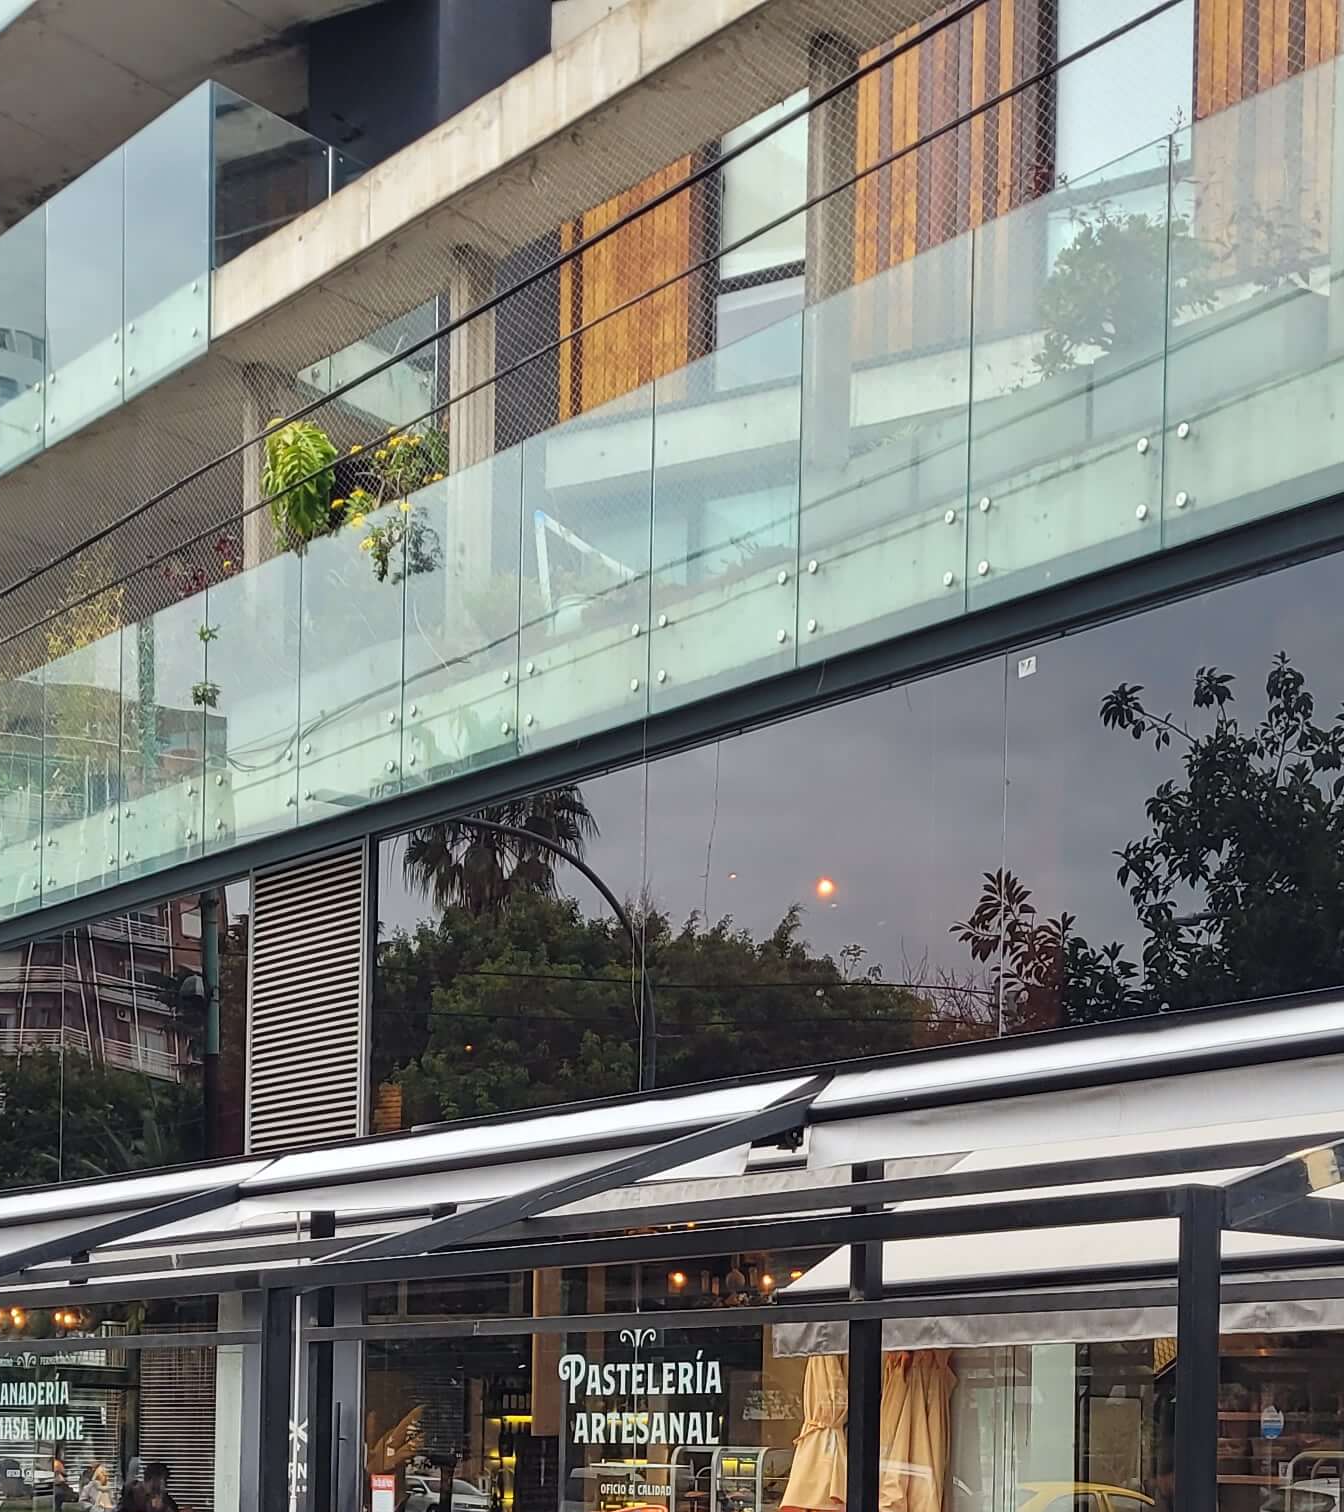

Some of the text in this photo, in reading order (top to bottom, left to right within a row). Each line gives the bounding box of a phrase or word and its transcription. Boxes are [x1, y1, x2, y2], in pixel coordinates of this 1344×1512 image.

[558, 1350, 723, 1404] PASTELERÍA
[34, 1416, 84, 1440] MADRE
[573, 1411, 720, 1445] ARTESANAL
[600, 1483, 626, 1495] OFICIO
[637, 1484, 672, 1496] CALIDAD
